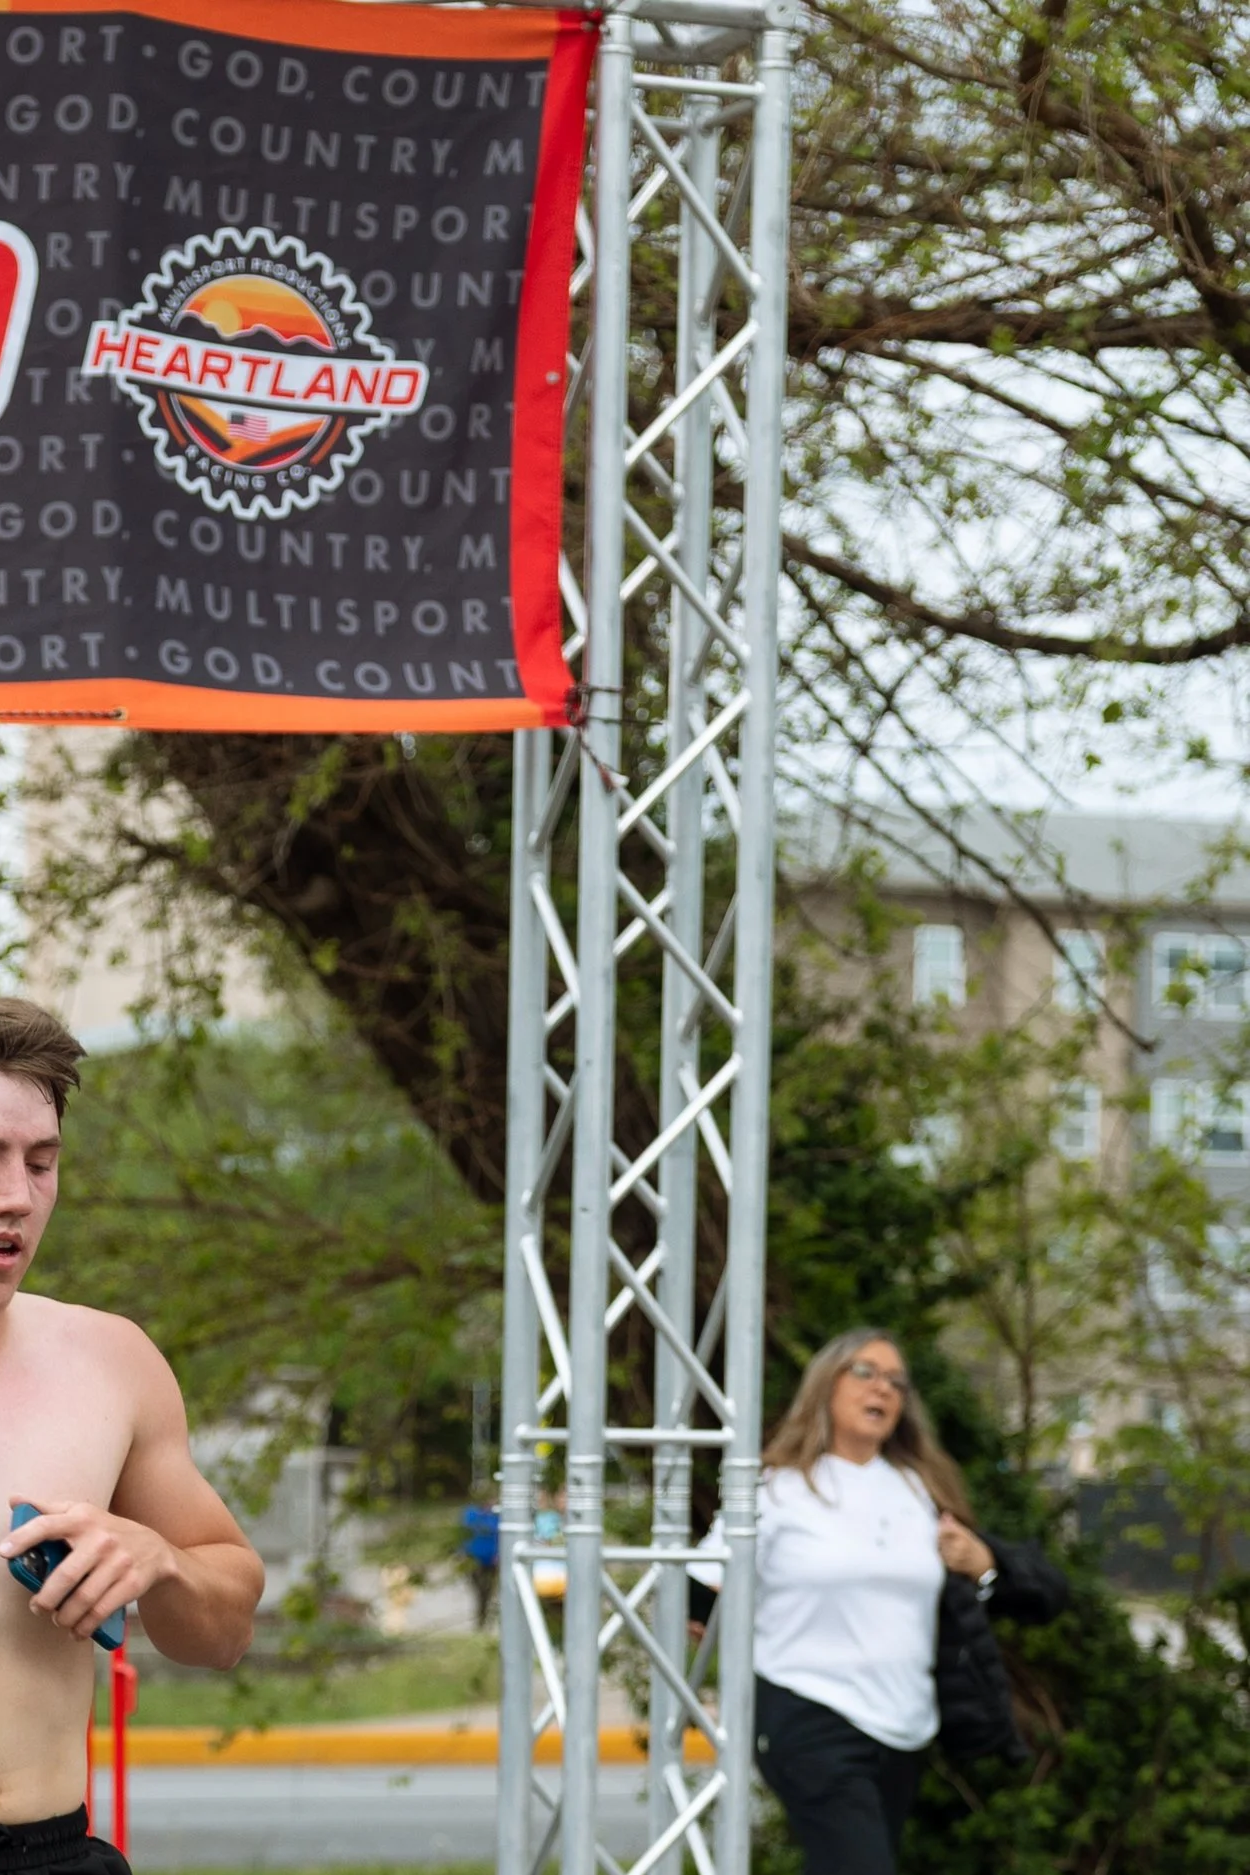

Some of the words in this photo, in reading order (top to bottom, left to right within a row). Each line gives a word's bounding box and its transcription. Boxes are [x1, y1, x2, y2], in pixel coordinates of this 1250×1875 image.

[177, 40, 315, 100] GOD,
[5, 94, 145, 138] GOD,
[171, 107, 458, 178] COUNTRY,
[157, 256, 247, 327] MULTISPORT
[338, 267, 526, 308] OUNT
[91, 328, 422, 406] HEARTLAND
[323, 467, 511, 507] OUNT
[153, 509, 433, 573] COUNTRY,
[158, 638, 293, 690] GOD,
